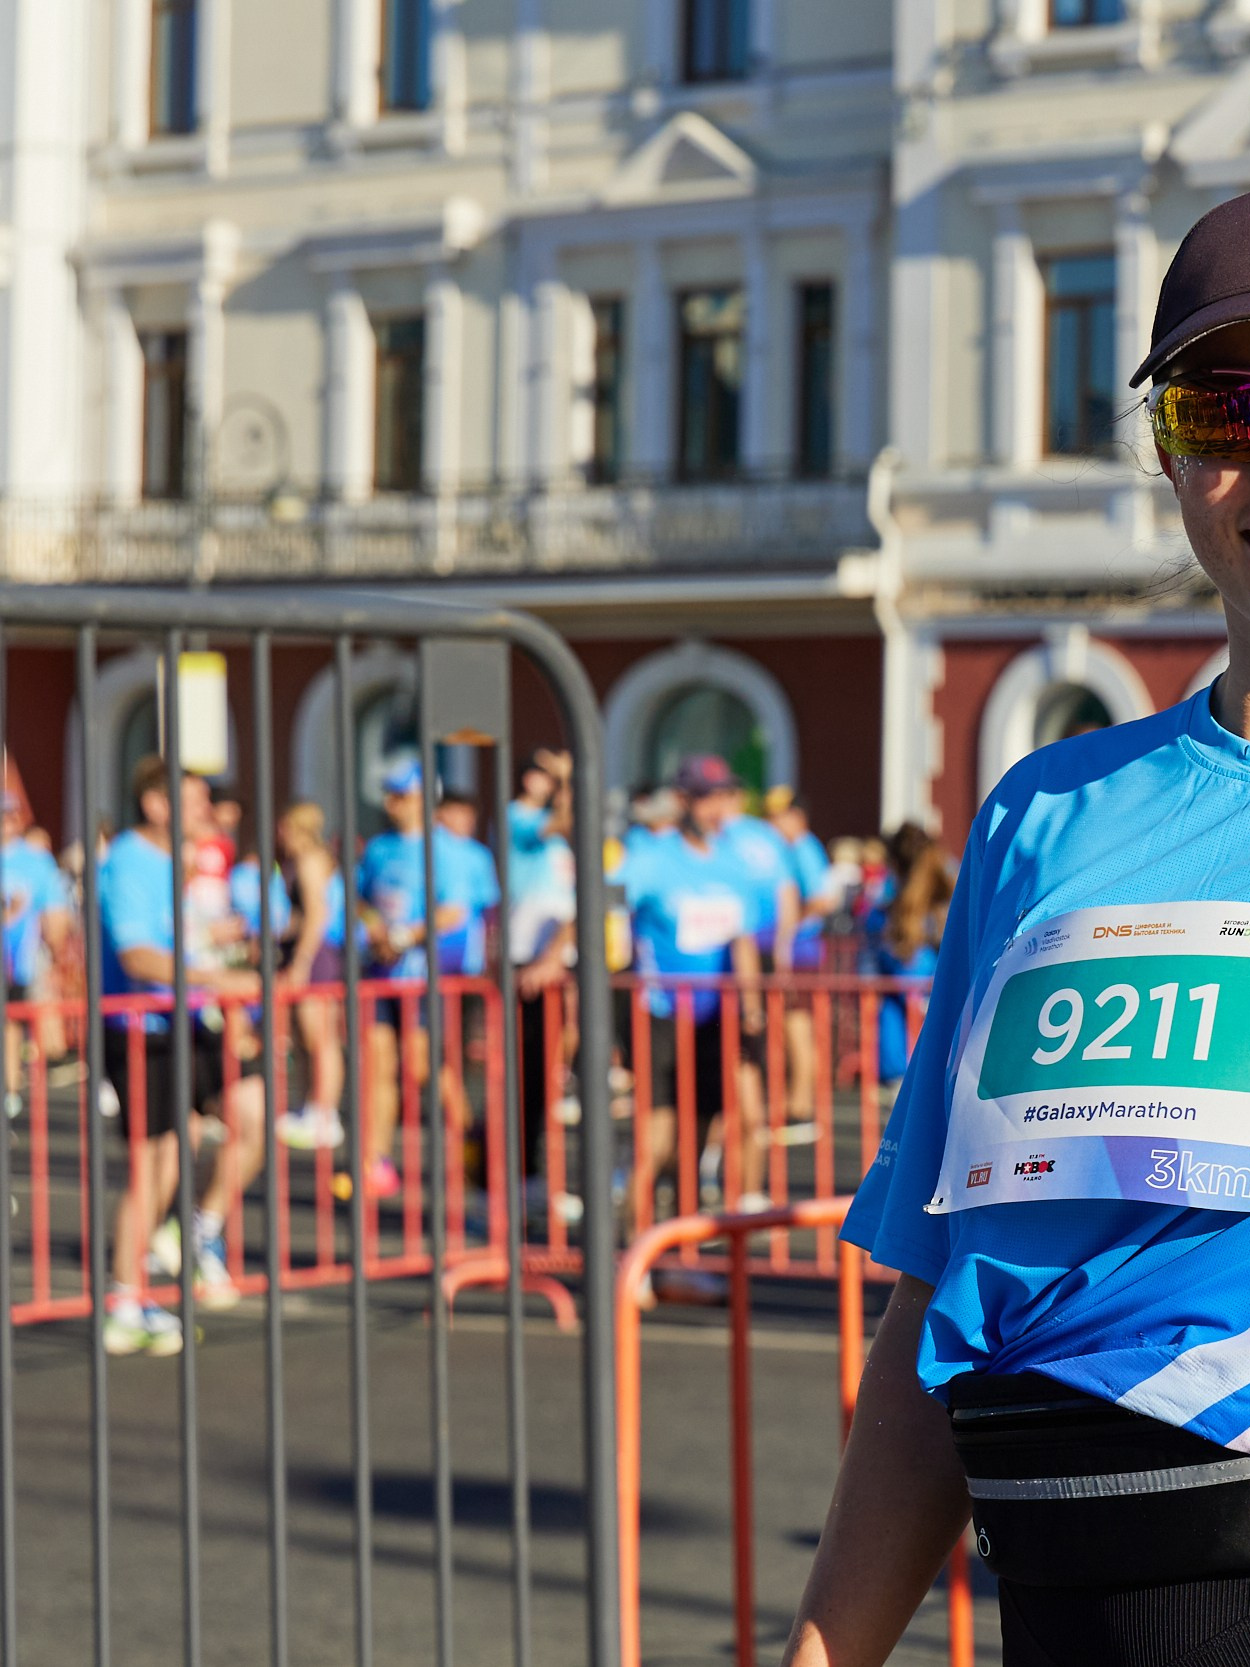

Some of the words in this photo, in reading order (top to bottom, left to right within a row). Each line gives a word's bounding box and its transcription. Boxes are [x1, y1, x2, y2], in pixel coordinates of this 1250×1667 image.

[1093, 925, 1133, 939] DNS
[1031, 982, 1221, 1066] 9211
[1023, 1101, 1198, 1123] #GalaxyMarathon
